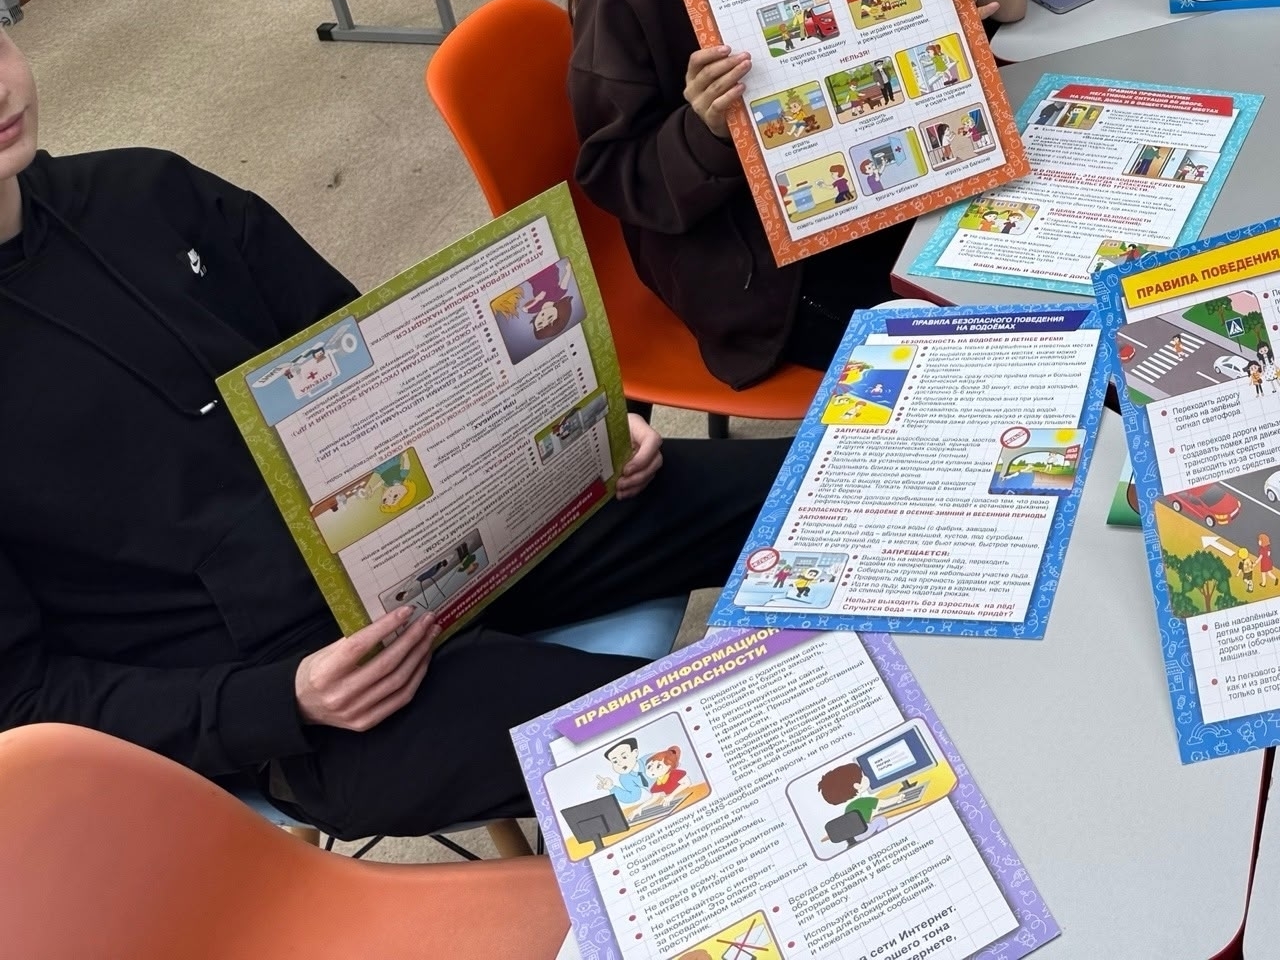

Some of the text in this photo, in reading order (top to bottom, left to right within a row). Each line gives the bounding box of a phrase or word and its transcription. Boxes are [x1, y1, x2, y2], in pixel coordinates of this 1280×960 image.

[1136, 272, 1199, 299] ПРАВИЛА
[1200, 248, 1280, 280] ПОВЕДЕНИЯ
[951, 316, 1012, 324] БЕЗОПАСНОГО
[1013, 315, 1064, 323] ПОВЕДЕНИЯ
[969, 322, 1016, 330] ВОДОЁМАХ
[574, 625, 779, 727] ПРАВИЛА ИНФОРМАЦИОН
[639, 644, 767, 712] БЕЗОПАСНОСТИ
[788, 836, 908, 905] Всегда сообщайте взрослым
[870, 938, 897, 957] сети
[921, 922, 950, 941] тона
